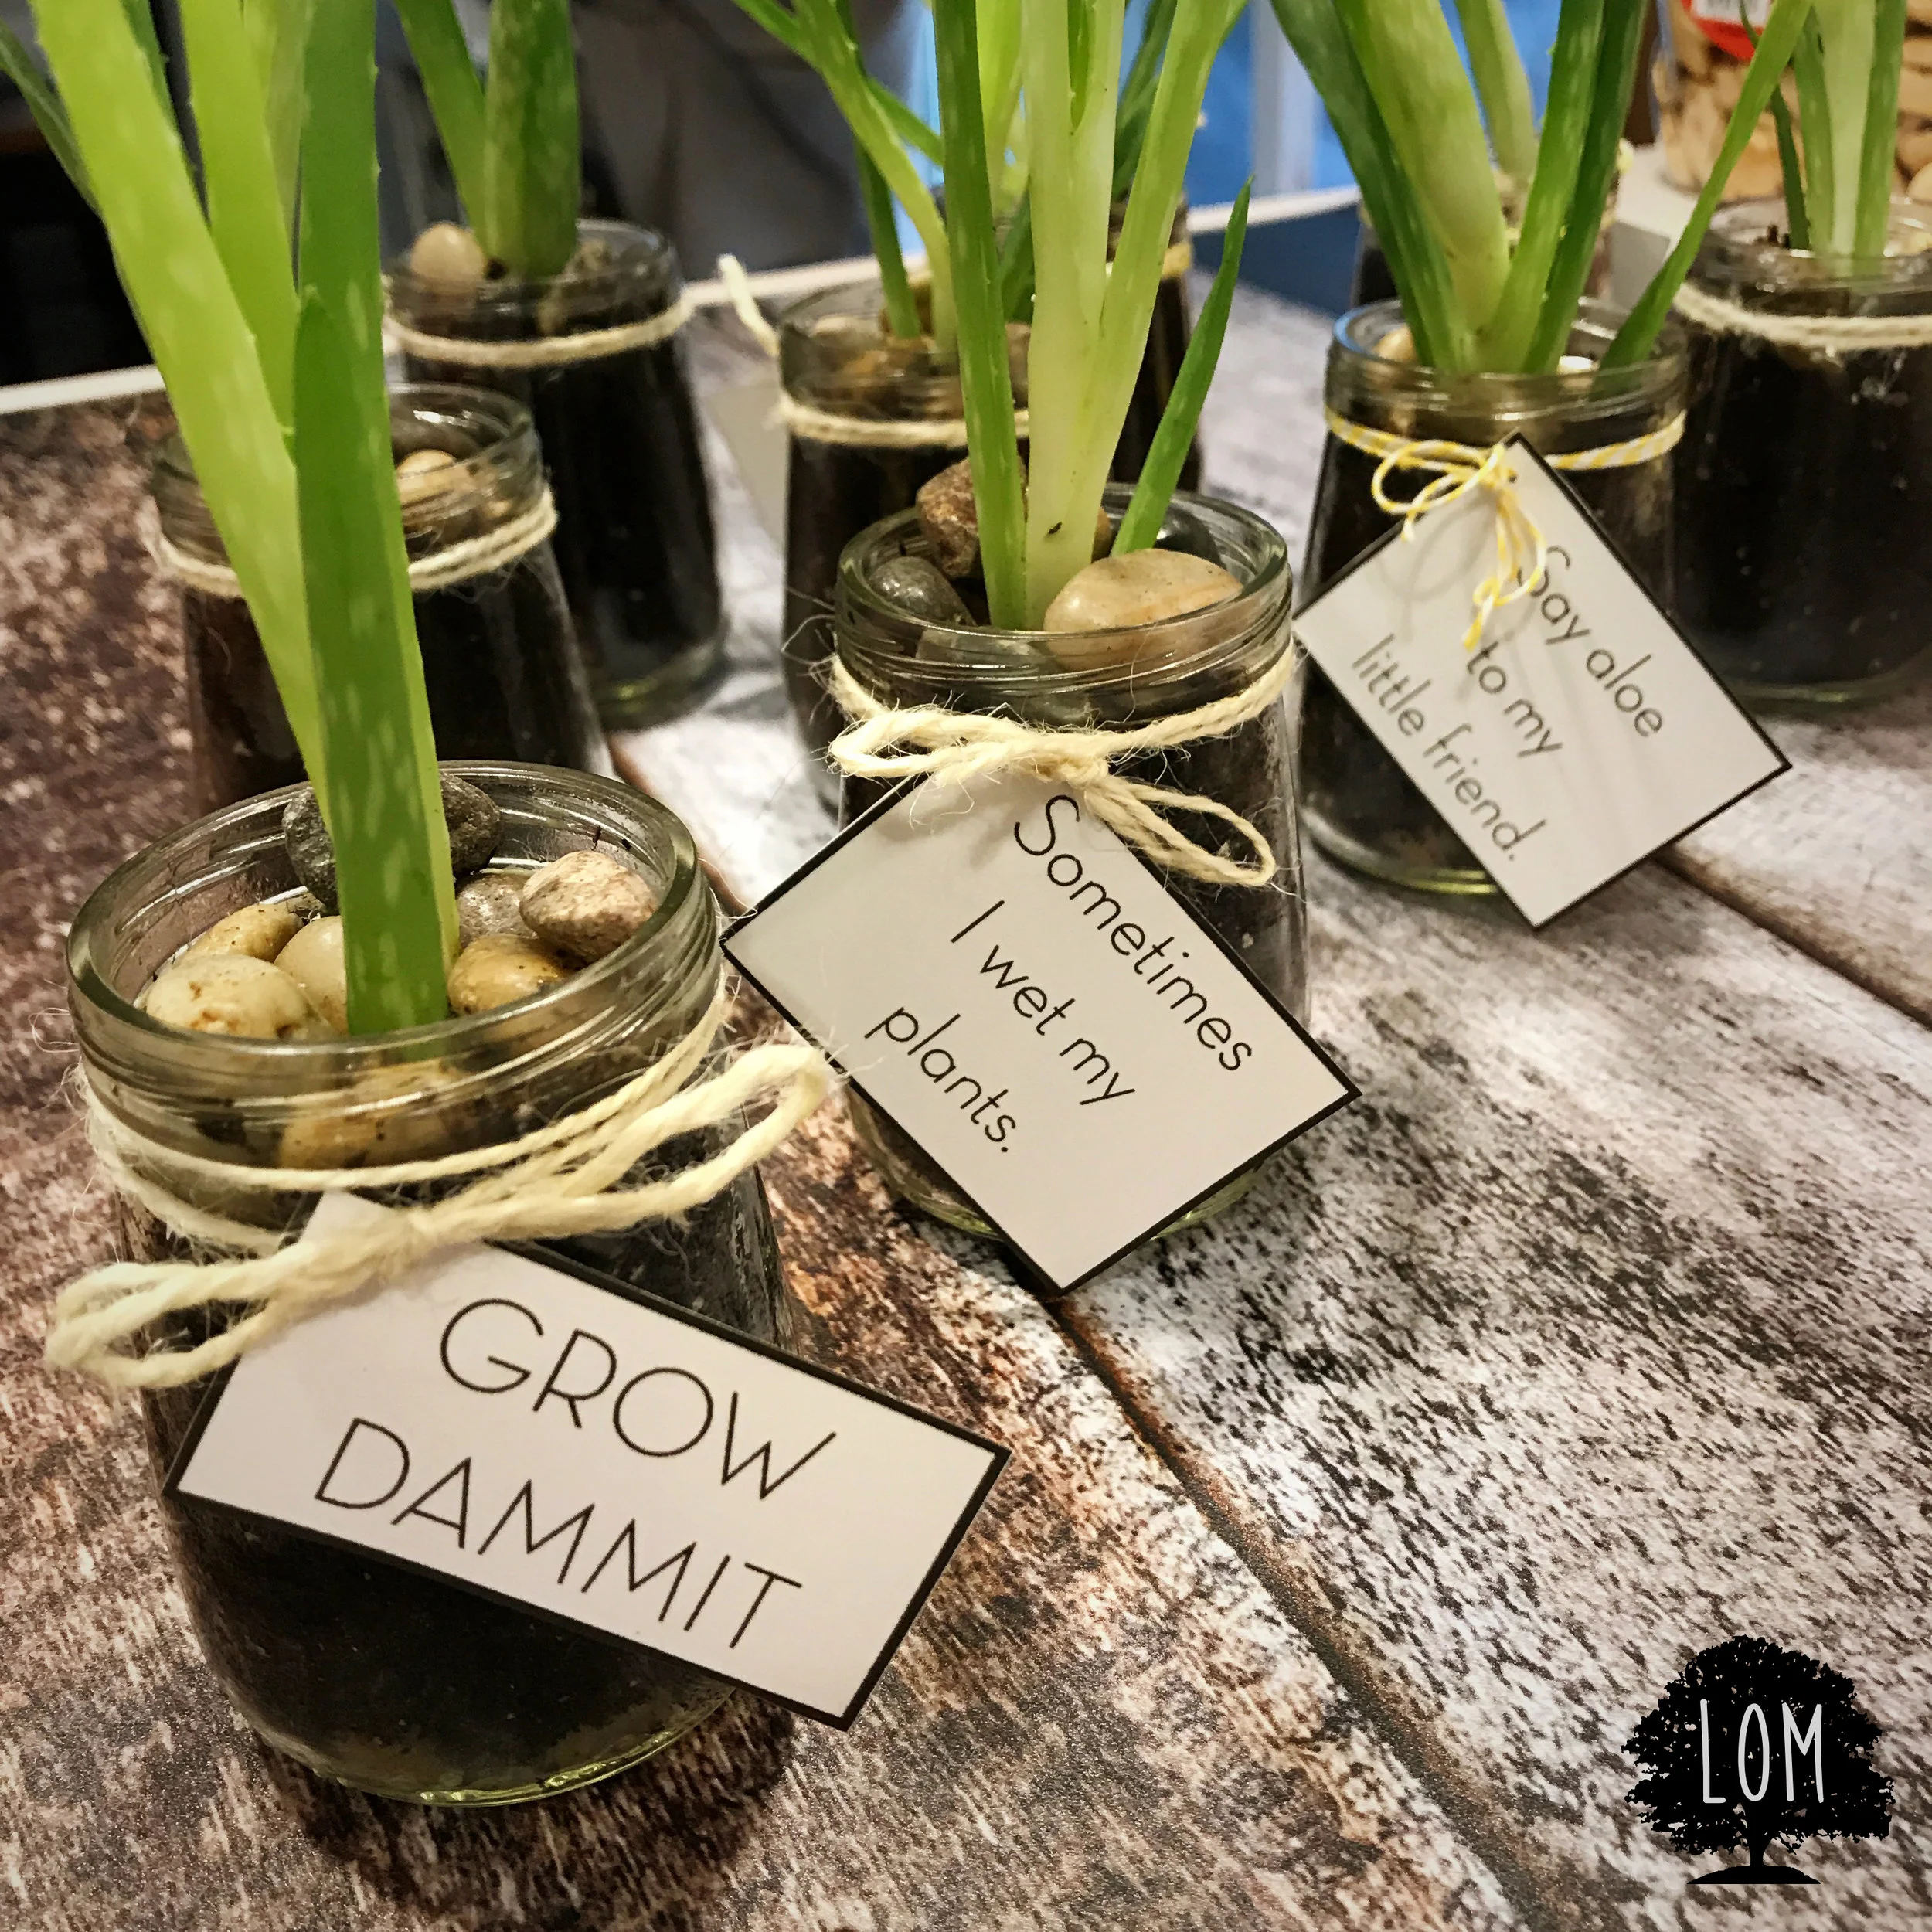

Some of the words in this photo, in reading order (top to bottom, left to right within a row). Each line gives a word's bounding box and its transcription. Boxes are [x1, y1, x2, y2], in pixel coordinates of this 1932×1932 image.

[1466, 641, 1507, 694] to
[1504, 698, 1563, 758] my
[1517, 545, 1591, 645] Say
[1587, 654, 1663, 738] aloe
[1352, 634, 1431, 736] little
[1423, 723, 1546, 861] friend.
[951, 900, 1005, 944] I
[980, 945, 1075, 1036] wet
[1060, 1039, 1134, 1106] my
[1014, 794, 1252, 1071] Sometimes
[864, 1007, 1018, 1153] plants.
[440, 1298, 836, 1499] GROW
[315, 1417, 802, 1648] DAMMIT
